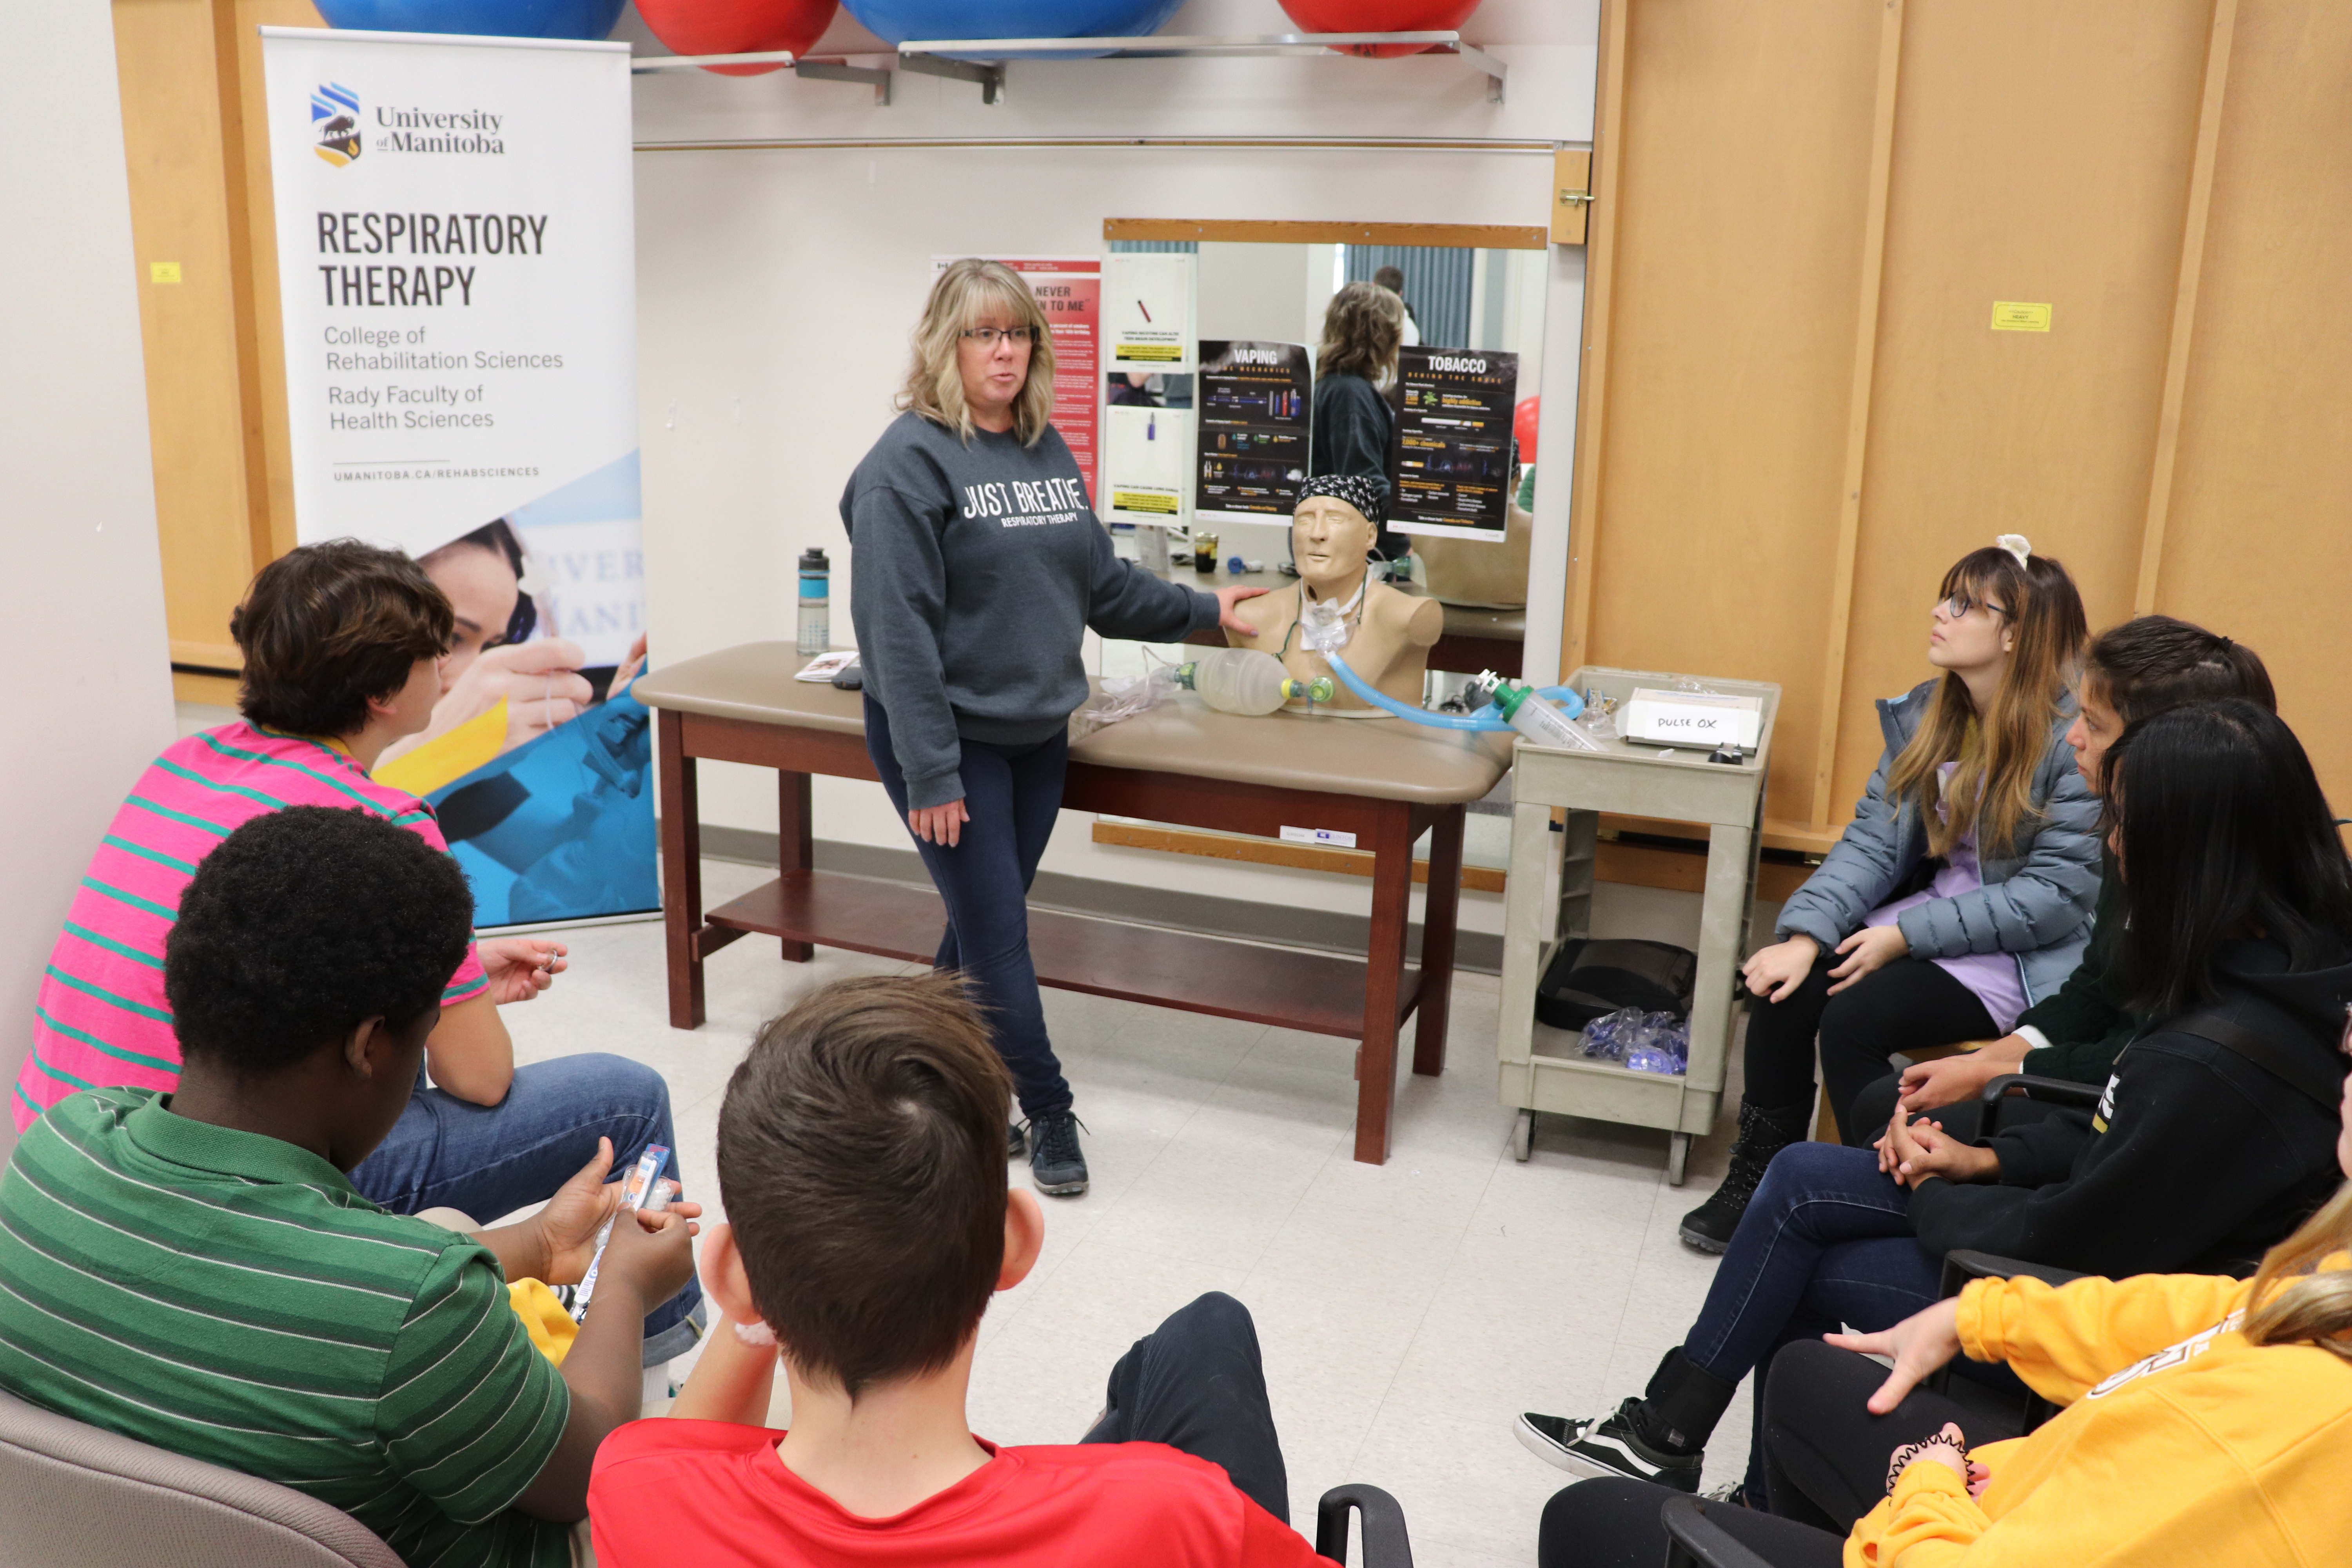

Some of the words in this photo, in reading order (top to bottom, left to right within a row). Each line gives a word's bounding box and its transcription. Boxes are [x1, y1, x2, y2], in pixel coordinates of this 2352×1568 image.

[376, 107, 503, 134] University
[376, 136, 388, 150] of
[391, 131, 505, 154] Manitoba
[318, 212, 548, 255] RESPIRATORY
[319, 265, 475, 306] THERAPY
[1035, 286, 1071, 297] NEVER
[1051, 300, 1064, 311] TO
[1067, 300, 1084, 312] ME
[324, 326, 400, 348] College
[407, 326, 425, 344] of
[327, 351, 467, 370] Rehabilitation
[474, 350, 563, 369] Sciences
[1235, 349, 1278, 365] VAPING
[1428, 355, 1486, 374] TOBACCO
[328, 386, 379, 407] Rady
[387, 385, 458, 406] Faculty
[465, 384, 483, 402] of
[330, 412, 397, 430] Health
[404, 410, 494, 429] Sciences
[334, 467, 539, 481] UMANITOBA.CA/REHABSCIENCES
[964, 482, 1013, 519] JUST
[1001, 515, 1047, 528] RESPIRATORY
[1047, 512, 1078, 524] THERAPY
[1658, 718, 1691, 728] PULSE
[1697, 718, 1718, 729] OX
